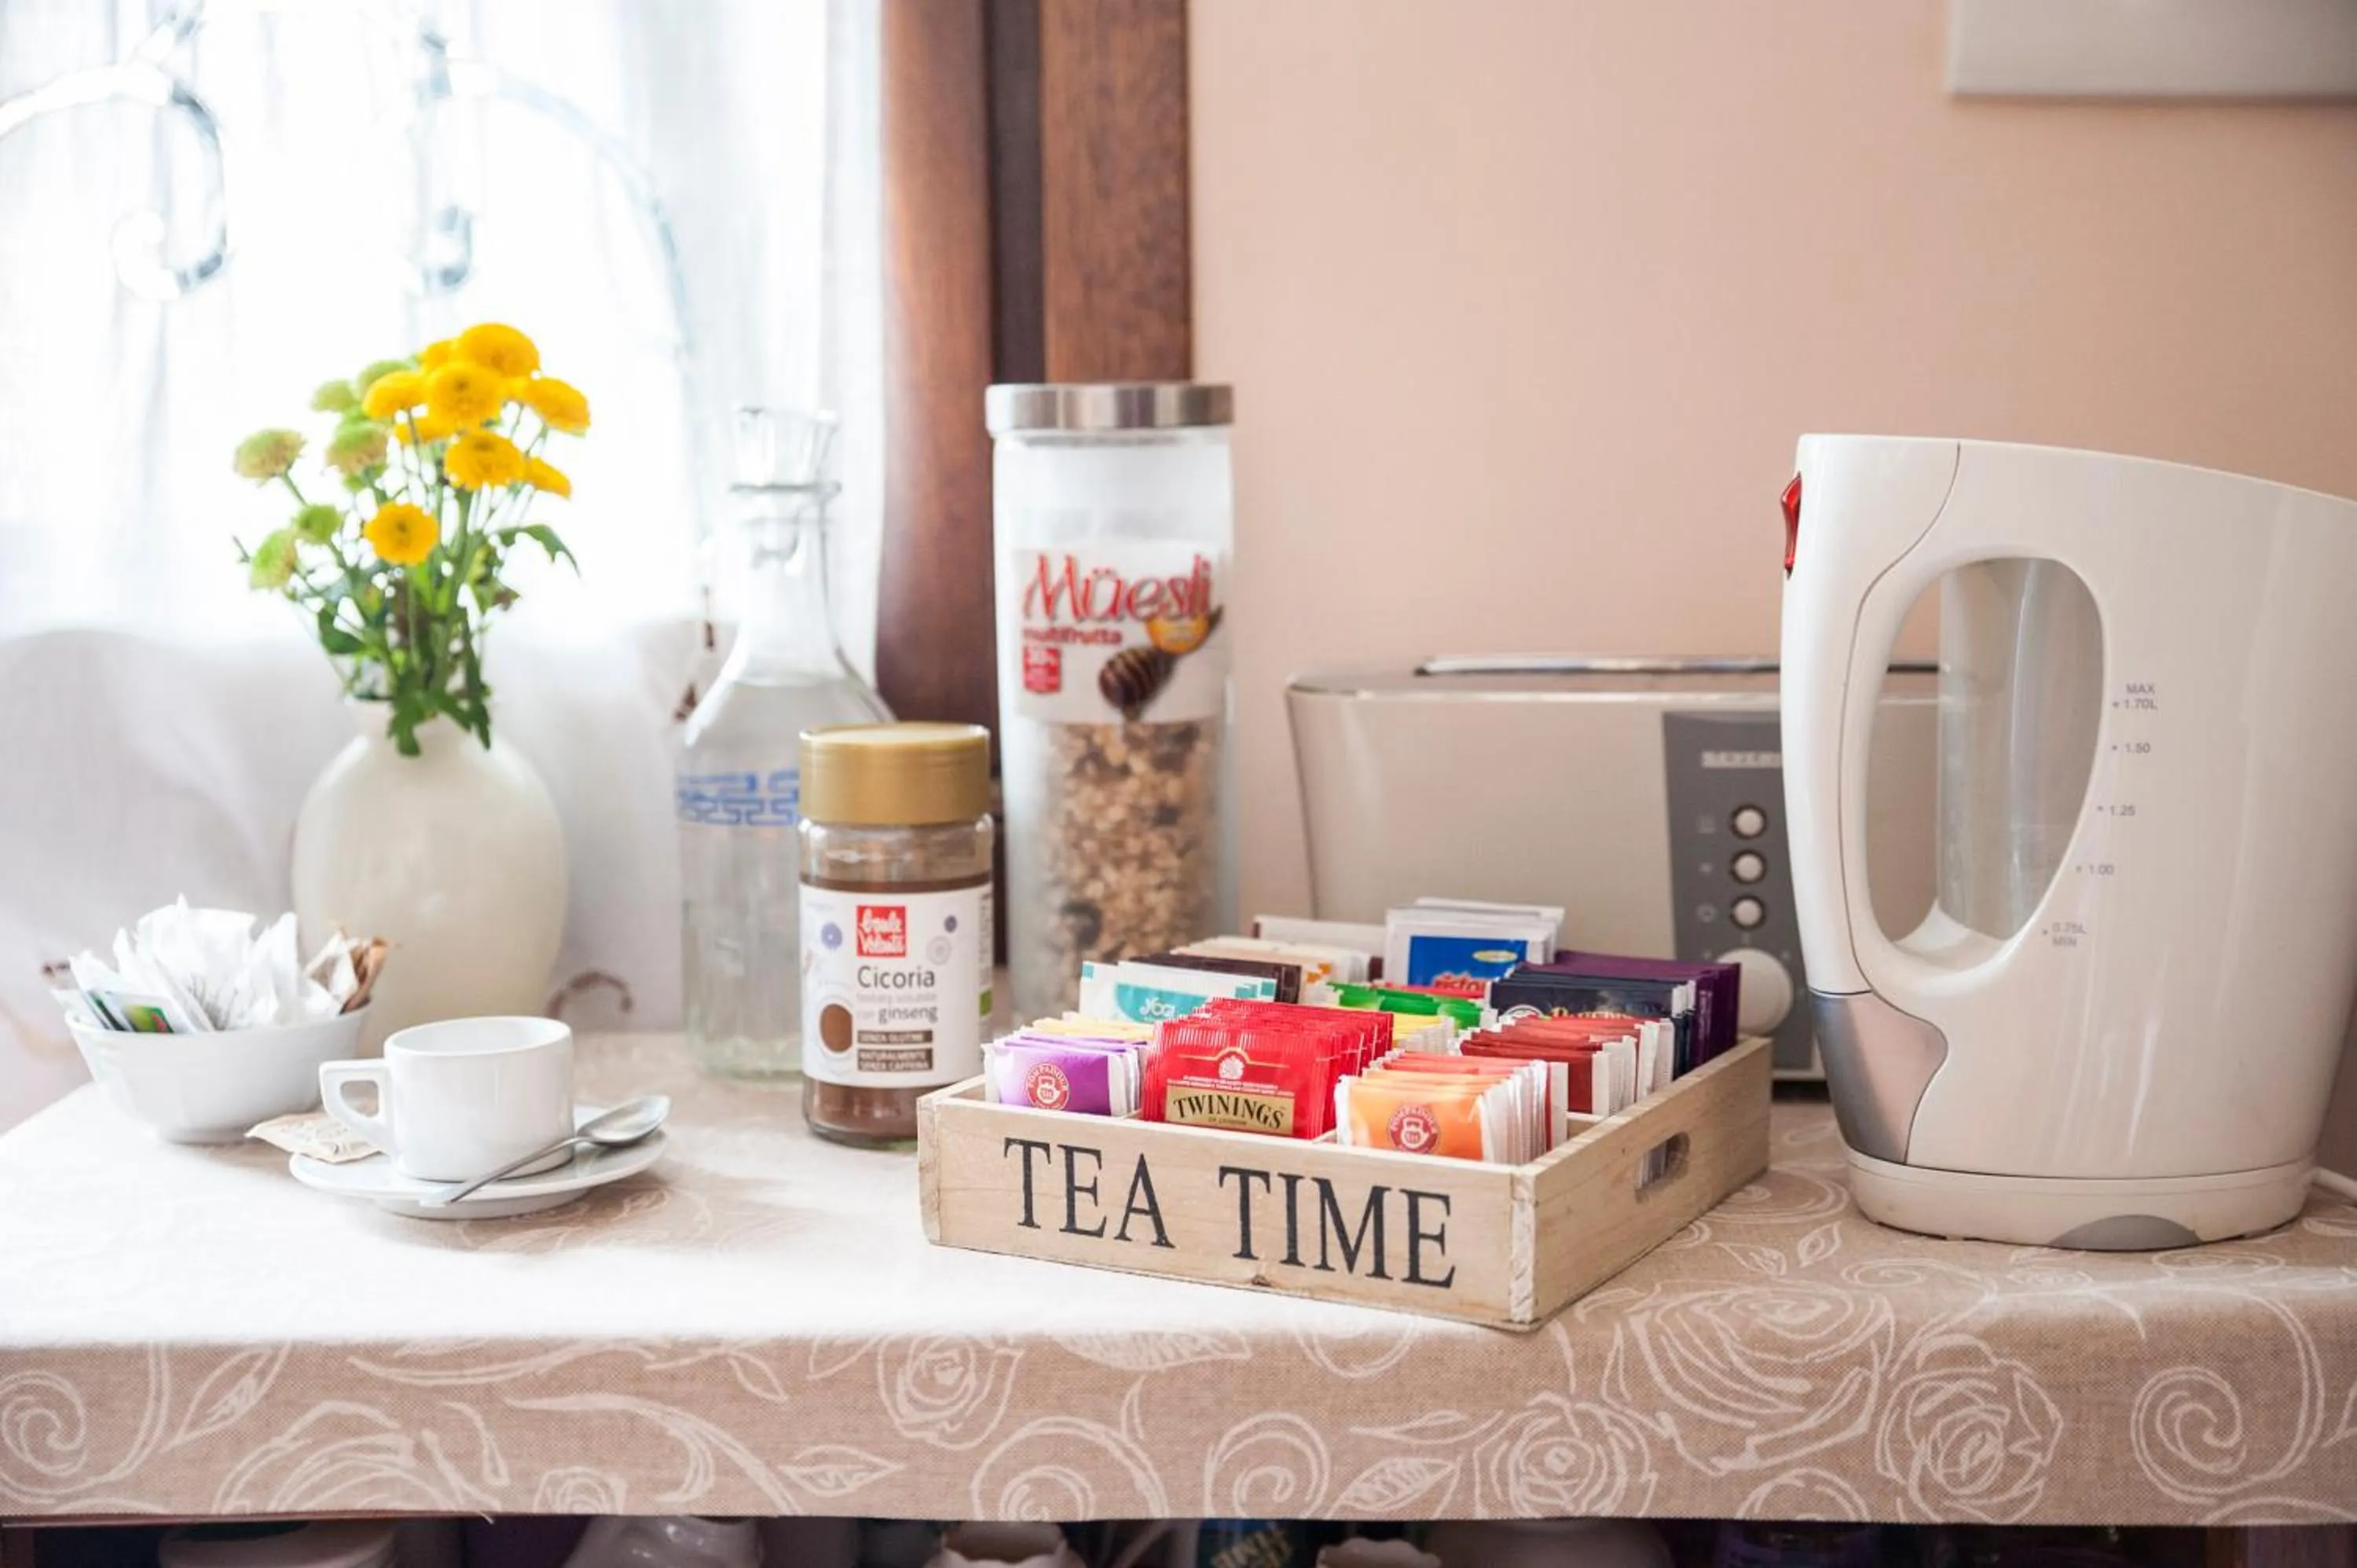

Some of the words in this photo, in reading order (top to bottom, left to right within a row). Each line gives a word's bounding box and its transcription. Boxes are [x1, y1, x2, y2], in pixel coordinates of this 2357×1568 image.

[2126, 683, 2156, 694] MAX
[2125, 742, 2151, 753] 1.50
[2110, 804, 2135, 817] 1.25
[2088, 864, 2114, 876] 1.00
[857, 964, 935, 989] Cicoria
[878, 1006, 938, 1025] ginseng
[1174, 1094, 1284, 1129] TWININGS
[1004, 1137, 1176, 1249] TEA
[1219, 1165, 1457, 1289] TIME
